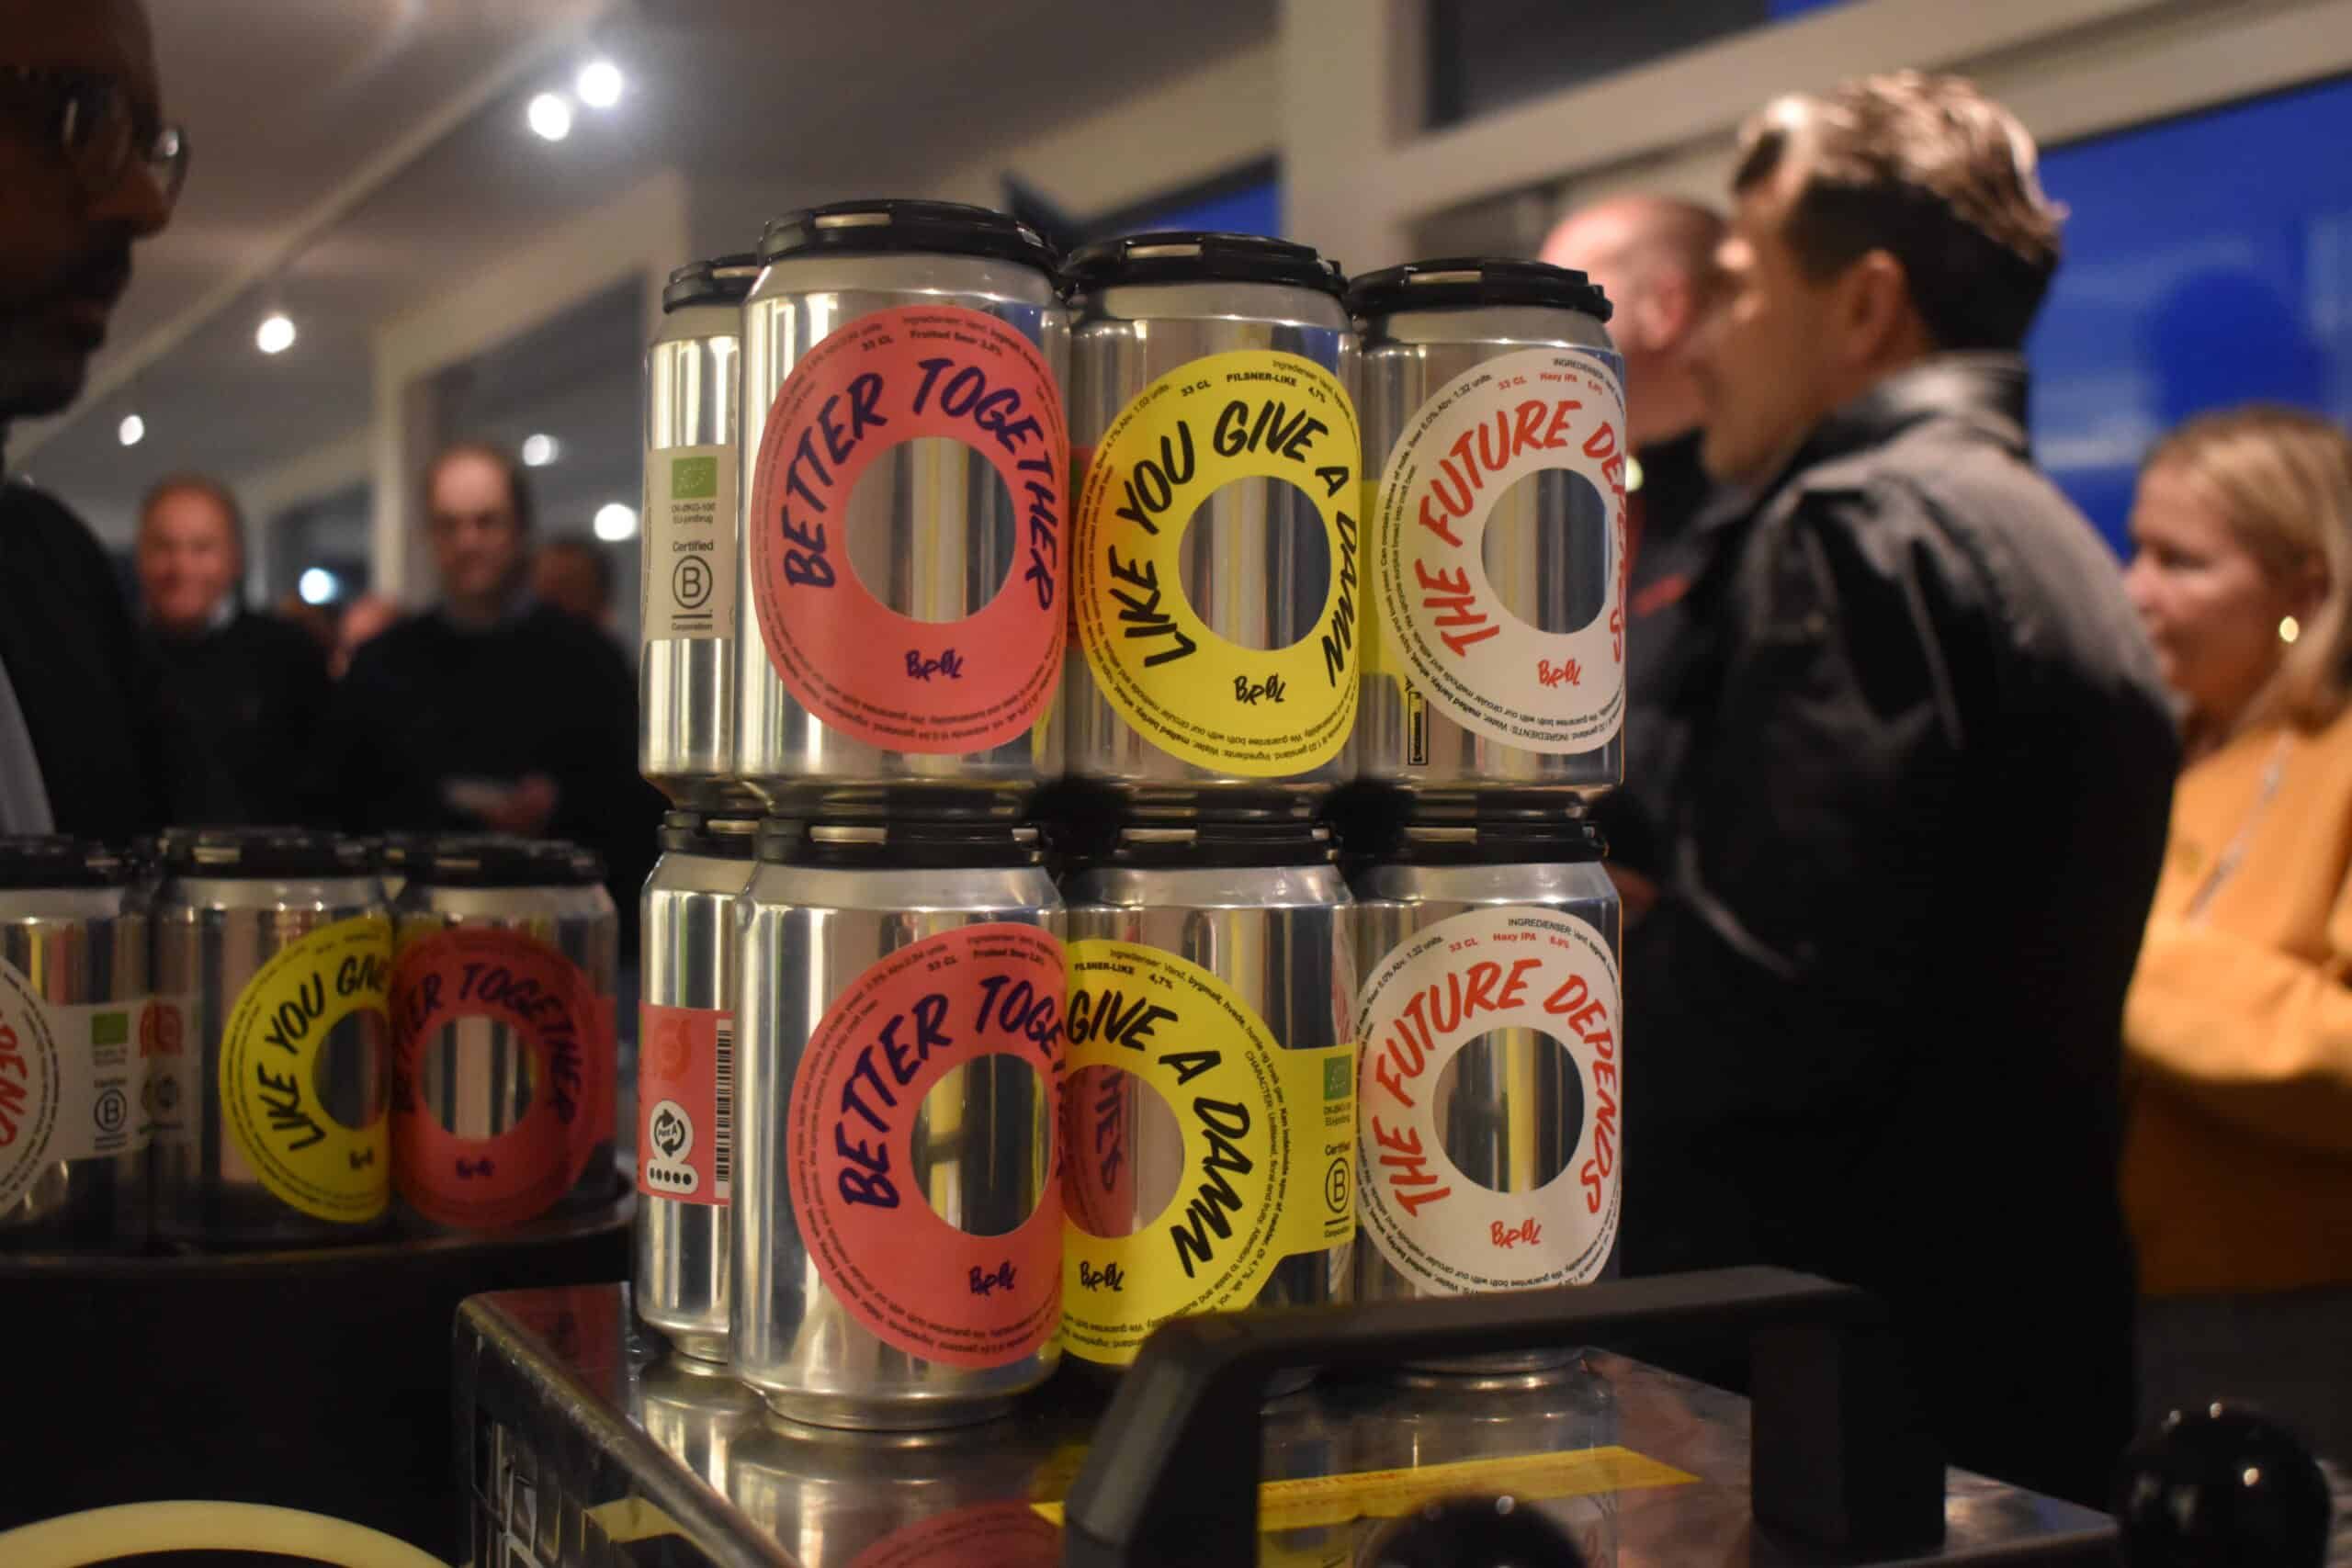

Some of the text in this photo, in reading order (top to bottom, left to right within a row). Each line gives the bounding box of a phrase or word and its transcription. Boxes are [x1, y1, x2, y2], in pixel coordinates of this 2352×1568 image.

[1181, 385, 1194, 397] 33
[1196, 378, 1212, 390] CL
[1226, 370, 1298, 388] PILSNER-LIKE
[1512, 375, 1527, 385] CL
[1213, 400, 1329, 464] GIVE
[782, 372, 889, 591] BETTER
[911, 357, 1062, 612] TOGETHER
[1115, 420, 1196, 536] YOU
[1315, 466, 1350, 498] A
[673, 540, 714, 552] Certified
[1415, 399, 1626, 663] THE FUTURE DEDS
[683, 566, 701, 599] B
[1109, 544, 1197, 669] LIKE
[1321, 510, 1358, 688] DAMN
[1429, 673, 1456, 700] barley,
[1159, 707, 1190, 731] circular
[1452, 694, 1483, 717] malted
[1473, 694, 1504, 715] circular
[1159, 722, 1191, 745] malted
[1205, 729, 1225, 742] with
[1227, 734, 1246, 746] both
[1421, 933, 1444, 952] units
[1448, 940, 1463, 953] 33
[1464, 938, 1478, 949] CL
[1493, 931, 1519, 944] Hazy
[1521, 932, 1537, 942] IPA
[1507, 917, 1573, 938] INGREDIENSER:
[1073, 960, 1173, 989] PILSNER-LIKE 4,7%
[265, 971, 325, 1055] YOU
[1185, 976, 1224, 1005] bygmalt,
[1220, 999, 1248, 1028] hvede,
[1066, 988, 1178, 1053] GIVE
[1374, 957, 1543, 1108] FUTURE
[459, 962, 583, 1126] TOGETHER
[1159, 1049, 1222, 1085] A
[1242, 1048, 1273, 1111] CHARACTER:
[257, 1061, 326, 1152] LIKE
[834, 993, 954, 1211] BETTER
[1544, 973, 1616, 1215] DEPENDS
[1373, 1114, 1451, 1217] THE
[1170, 1096, 1254, 1280] DAMN
[1333, 1168, 1346, 1203] B
[1384, 1232, 1408, 1259] barley,
[1405, 1254, 1434, 1278] malted
[1424, 1252, 1455, 1274] circular
[1469, 1272, 1488, 1284] with
[1488, 1277, 1509, 1287] both
